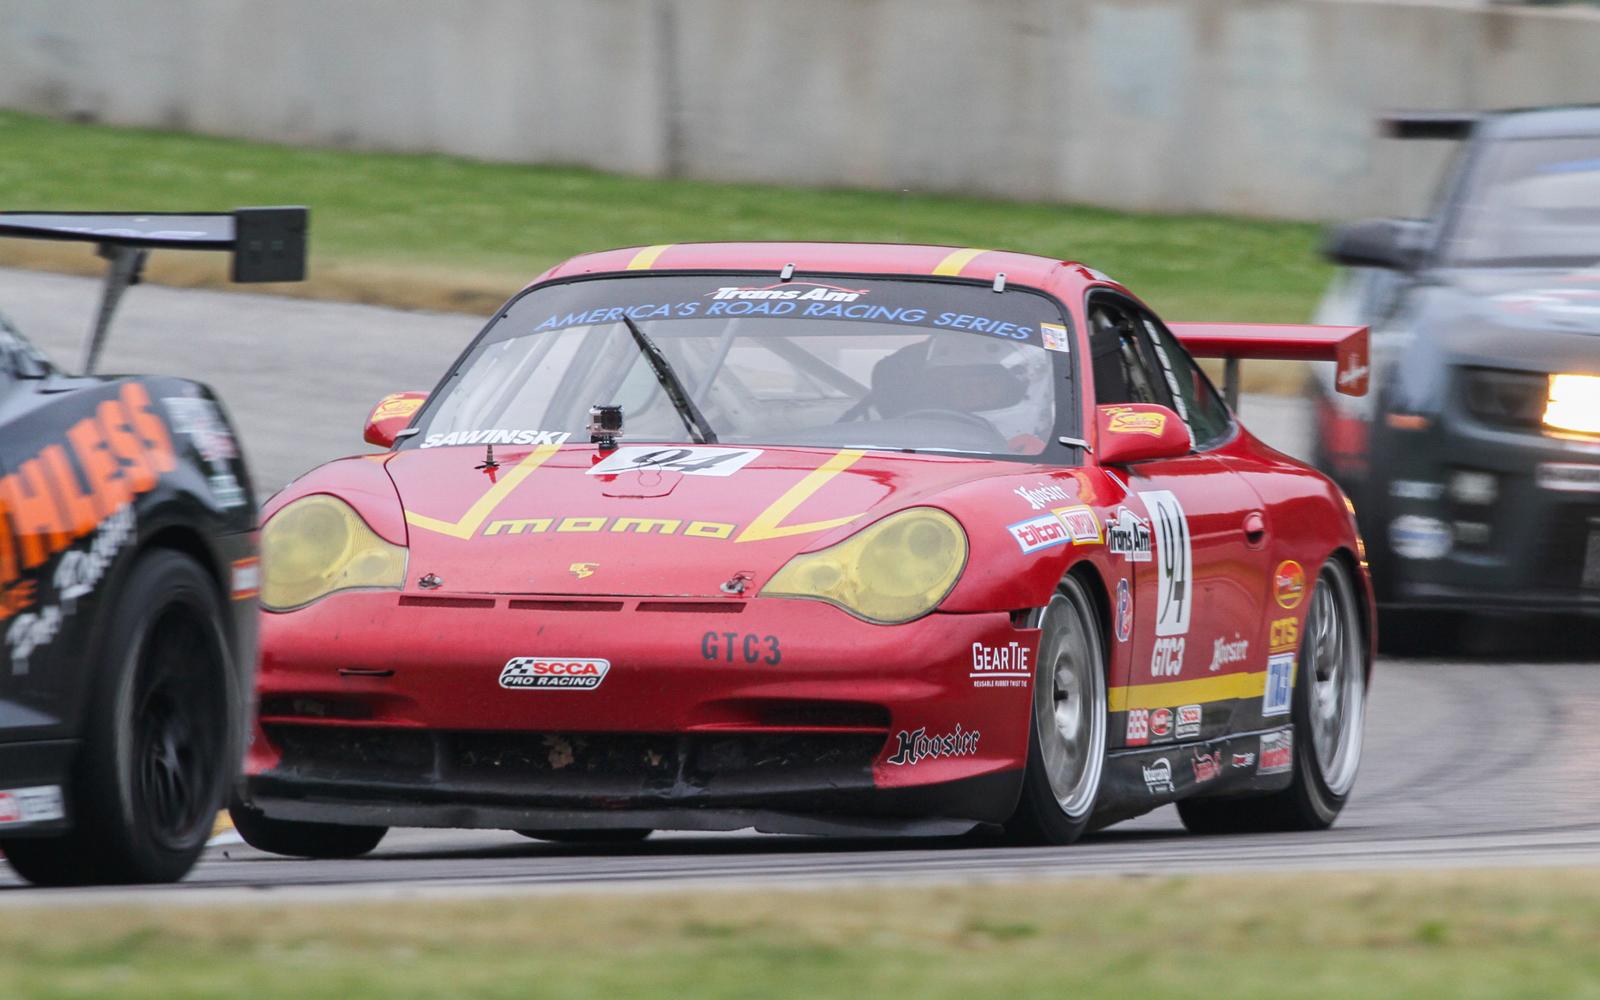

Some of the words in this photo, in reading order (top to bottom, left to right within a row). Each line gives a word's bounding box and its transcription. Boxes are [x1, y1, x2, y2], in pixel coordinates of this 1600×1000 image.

[713, 287, 802, 300] Trans
[798, 288, 861, 301] Am
[535, 301, 699, 332] AMERICA'S
[706, 301, 797, 316] ROAD
[802, 302, 925, 324] RACING
[933, 309, 1034, 341] SERIES
[420, 429, 571, 449] SAWINSKI
[600, 448, 748, 472] 94
[1016, 522, 1067, 548] tilton
[1107, 524, 1133, 551] Trans
[1133, 521, 1150, 552] Am
[1157, 500, 1187, 625] 94
[701, 630, 782, 665] GTC3
[1151, 637, 1186, 678] GTC3
[503, 675, 534, 686] PRO
[537, 676, 598, 687] RACING
[533, 662, 599, 675] SCCA
[887, 722, 980, 765] Hoosier
